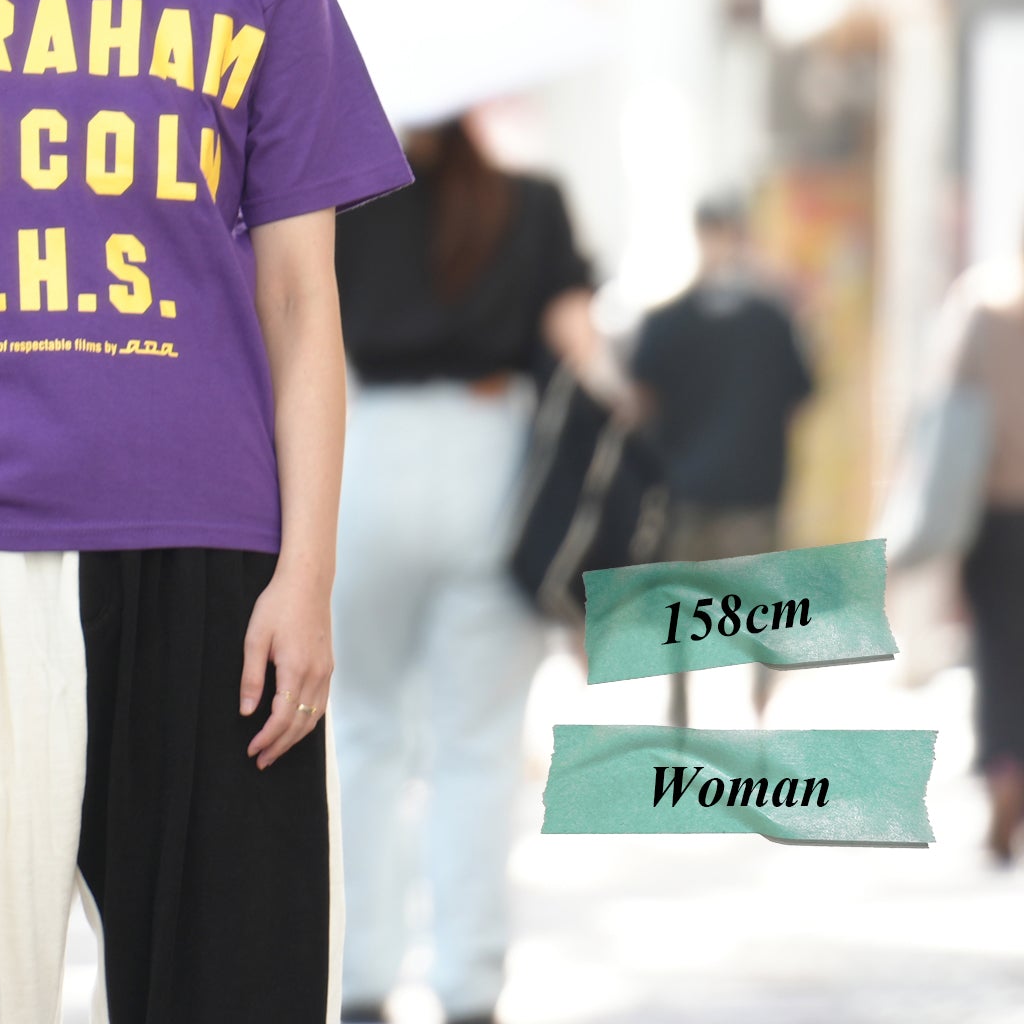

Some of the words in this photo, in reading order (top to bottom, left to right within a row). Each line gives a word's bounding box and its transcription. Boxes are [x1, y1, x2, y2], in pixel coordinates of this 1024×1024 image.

[10, 338, 72, 354] respectable
[74, 338, 102, 353] films
[104, 340, 118, 356] by
